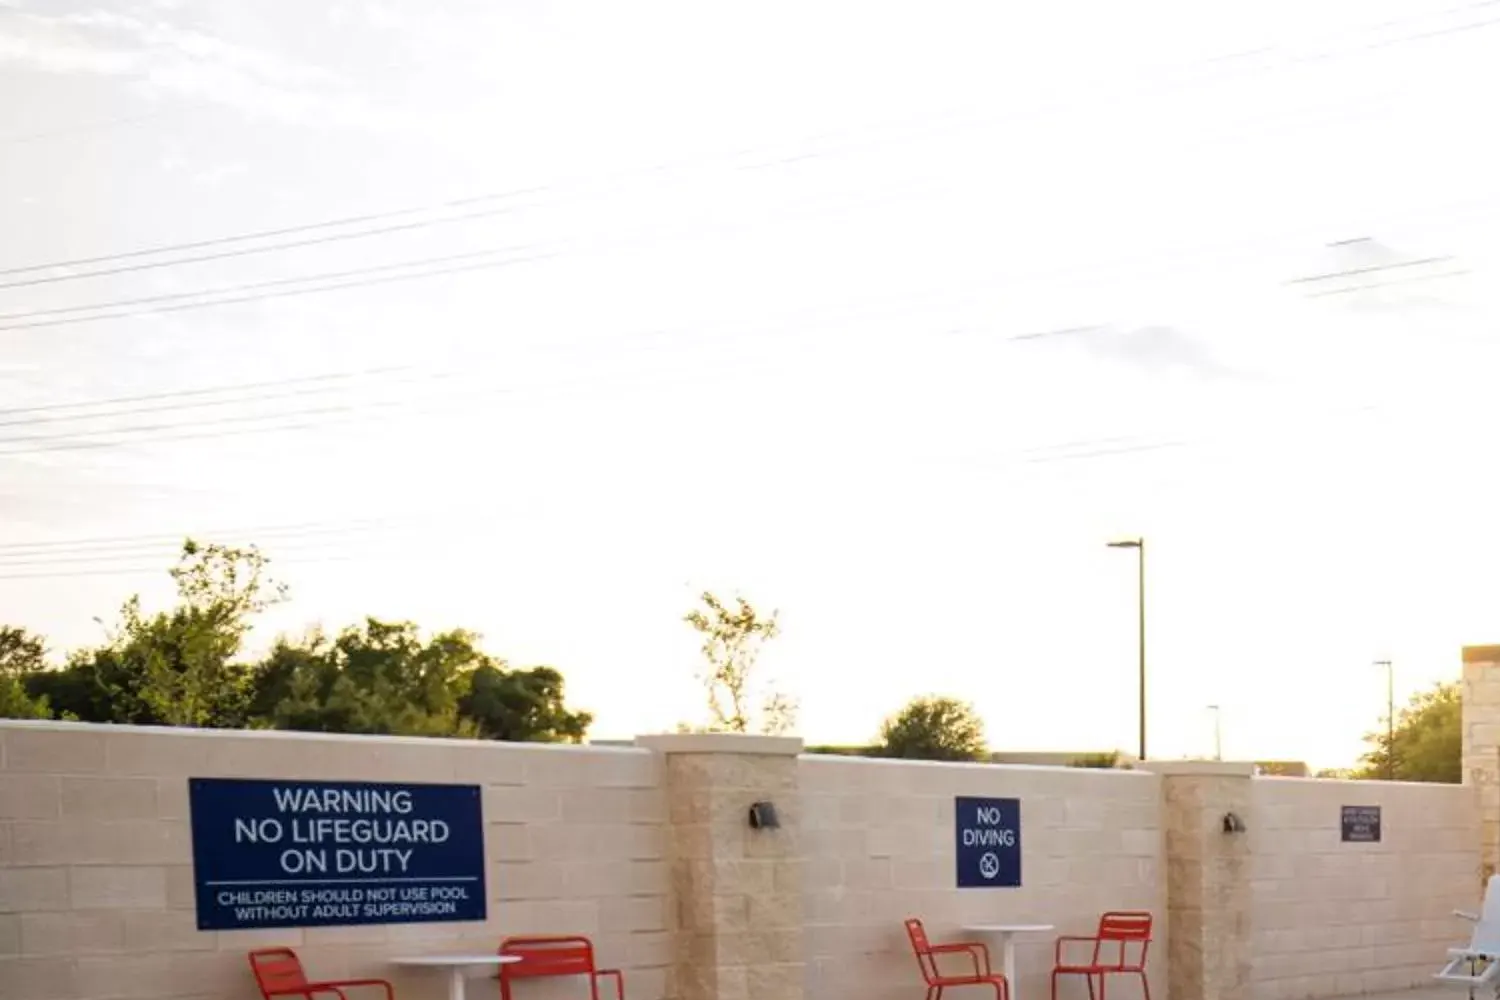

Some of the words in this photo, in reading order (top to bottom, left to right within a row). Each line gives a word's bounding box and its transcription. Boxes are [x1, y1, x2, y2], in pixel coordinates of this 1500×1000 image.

[273, 788, 412, 814] WARNING
[976, 807, 1001, 825] NO
[235, 818, 283, 843] NO
[292, 819, 449, 843] LIFEGUARD
[963, 829, 1016, 847] DIVING
[280, 849, 327, 873] ON
[336, 849, 413, 872] DUTY
[218, 890, 298, 906] CHILDREN
[301, 889, 364, 904] SHOULD
[366, 888, 398, 902] NOT
[400, 888, 429, 901] USE
[431, 886, 469, 900] POOL
[235, 904, 308, 921] WITHOUT
[312, 903, 360, 918] ADULT
[363, 901, 456, 916] SUPERVISION
